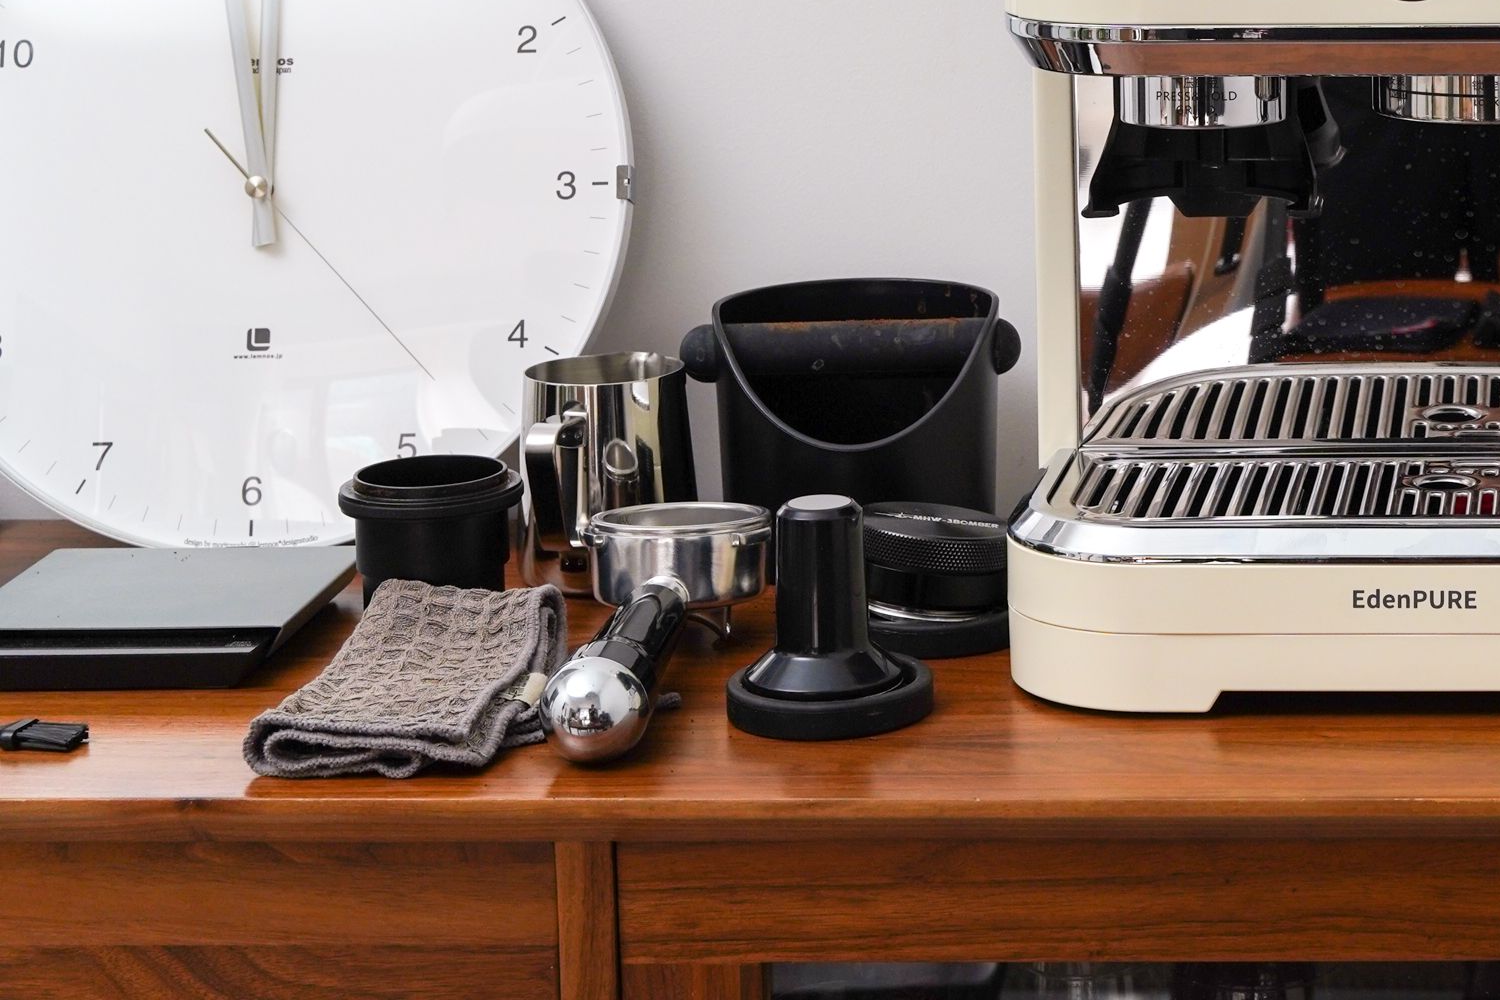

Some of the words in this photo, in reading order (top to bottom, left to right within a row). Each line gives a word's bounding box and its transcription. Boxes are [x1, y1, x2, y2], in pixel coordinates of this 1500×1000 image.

[517, 25, 537, 53] 2
[556, 171, 576, 200] 3
[507, 319, 528, 348] 4
[92, 442, 113, 470] 7
[397, 433, 417, 458] 5
[241, 476, 262, 506] 6
[1352, 588, 1477, 609] EdenPURE
